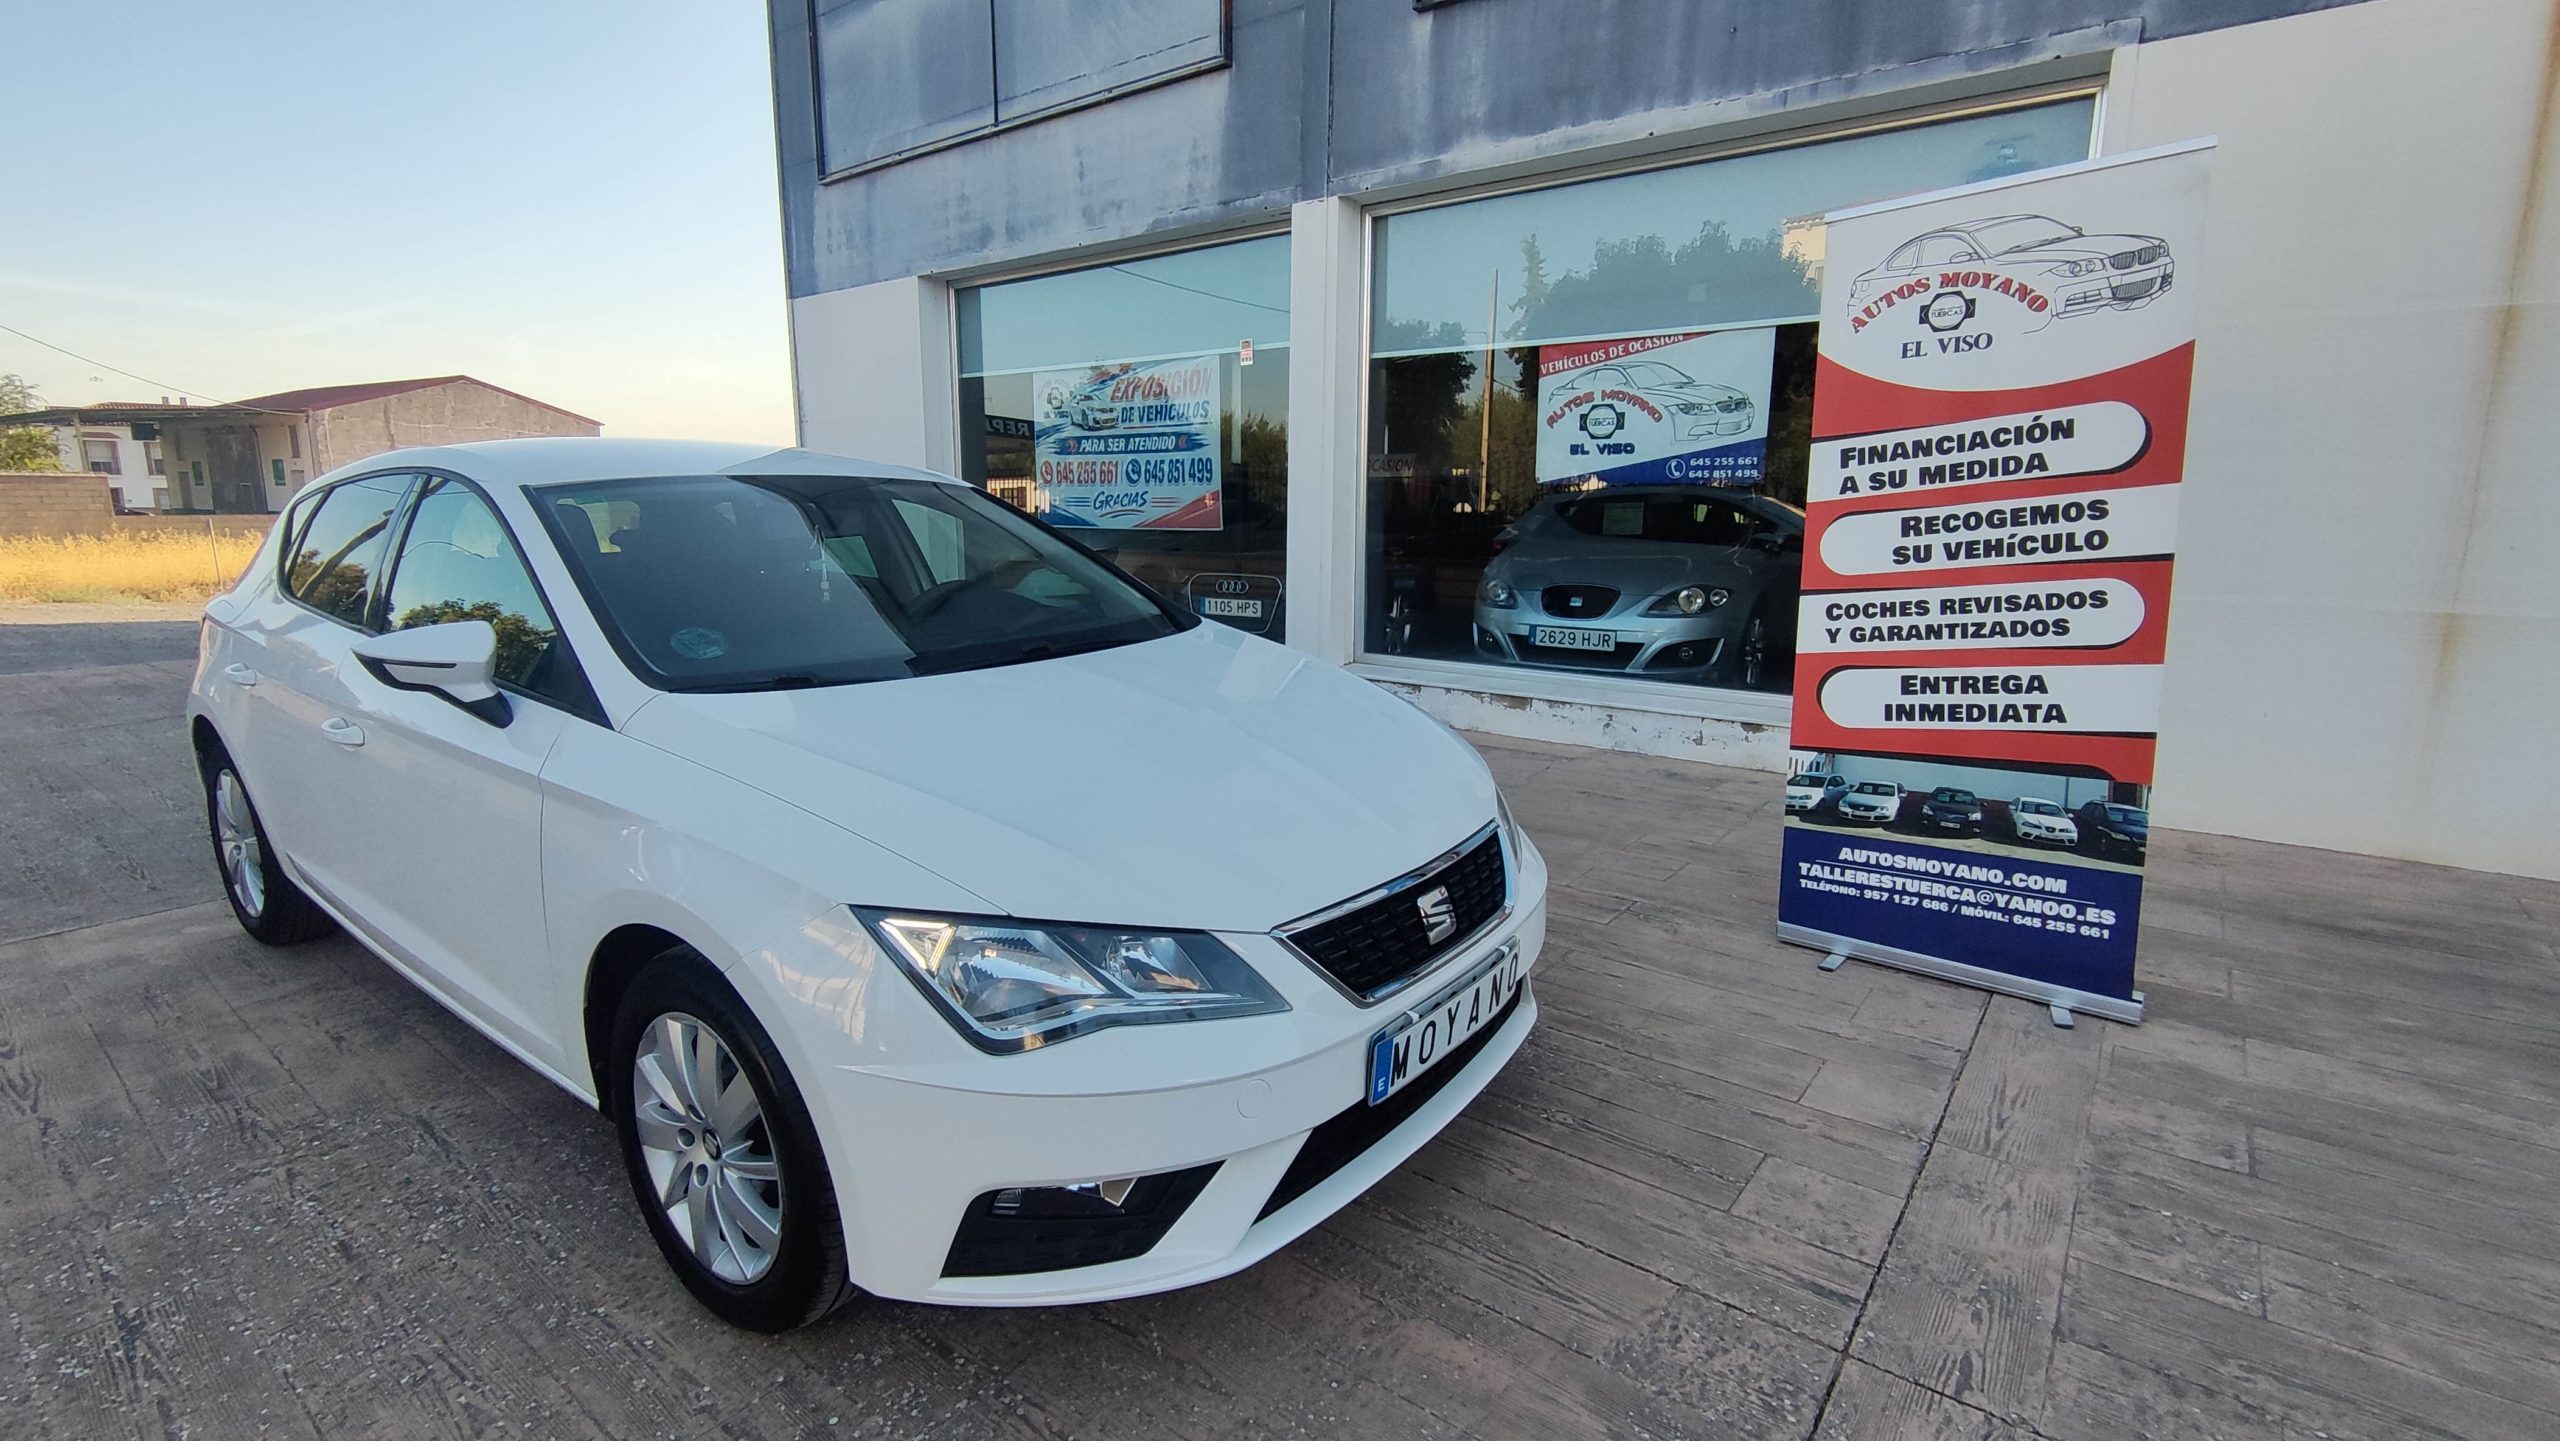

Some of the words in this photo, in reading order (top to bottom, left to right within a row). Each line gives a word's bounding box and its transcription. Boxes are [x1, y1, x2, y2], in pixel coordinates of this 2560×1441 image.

[1851, 276, 1931, 333] AUTOS
[1939, 271, 2049, 313] MOYANO
[1901, 340, 1928, 359] EL
[1937, 332, 1993, 354] VISO
[1541, 350, 1606, 375] VEHÍCULOS
[1609, 344, 1626, 359] DE
[1110, 365, 1213, 402] EXPOSICIÓN
[1121, 406, 1135, 423] DE
[1137, 399, 1210, 422] VEHÍCULOS
[1546, 391, 1595, 429] AUTOS
[1601, 389, 1663, 423] MOYANO
[1079, 439, 1105, 452] PARA
[1107, 437, 1125, 451] SER
[1127, 435, 1176, 451] ATENDIDO
[1570, 444, 1590, 456] EL
[1599, 443, 1635, 456] VISO
[1840, 415, 2076, 469] FINANCIACIÓN
[1056, 461, 1074, 484] 645
[1077, 460, 1097, 484] 255
[1099, 460, 1119, 484] 661
[1144, 459, 1165, 484] 645
[1167, 458, 1186, 483] 851
[1188, 457, 1213, 483] 499
[1688, 469, 1710, 479] 645
[1712, 469, 1732, 478] 851
[1735, 468, 1758, 478] 499
[1690, 457, 1711, 466] 645
[1714, 457, 1735, 466] 255
[1737, 456, 1758, 465] 661
[1839, 475, 1859, 495] A
[1868, 468, 1908, 492] SU
[1919, 452, 2049, 486] MEDIDA
[1093, 491, 1149, 511] GRACIAS
[1901, 499, 2110, 538] RECOGEMOS
[1892, 544, 1932, 565] SU
[1942, 529, 2110, 561] VEHÍCULO
[1207, 600, 1233, 613] 1105
[1236, 601, 1259, 615] HPS
[1825, 599, 1931, 622] COCHES
[1939, 590, 2109, 616] REVISADOS
[1539, 629, 1577, 646] 2629
[1581, 632, 1611, 649] HJR
[1825, 628, 1841, 643] Y
[1849, 618, 2071, 643] GARANTIZADOS
[1900, 674, 2049, 695] ENTREGA
[1884, 703, 2068, 723] INMEDIATA
[1838, 846, 2067, 894] AUTOSMOYANO.COM
[1799, 862, 2117, 925] TALLERESTUERCA@YAHOO.ES
[1799, 878, 1861, 898] TELÉFONO:
[1863, 889, 1888, 902] 957
[1893, 894, 1919, 907] 127
[1922, 898, 1949, 912] 686
[1960, 902, 2010, 924] MÓVIL:
[2013, 913, 2042, 929] 645
[2045, 919, 2077, 934] 255
[2080, 924, 2110, 940] 661
[1377, 1077, 1386, 1093] E
[1391, 952, 1518, 1088] MOYANO
